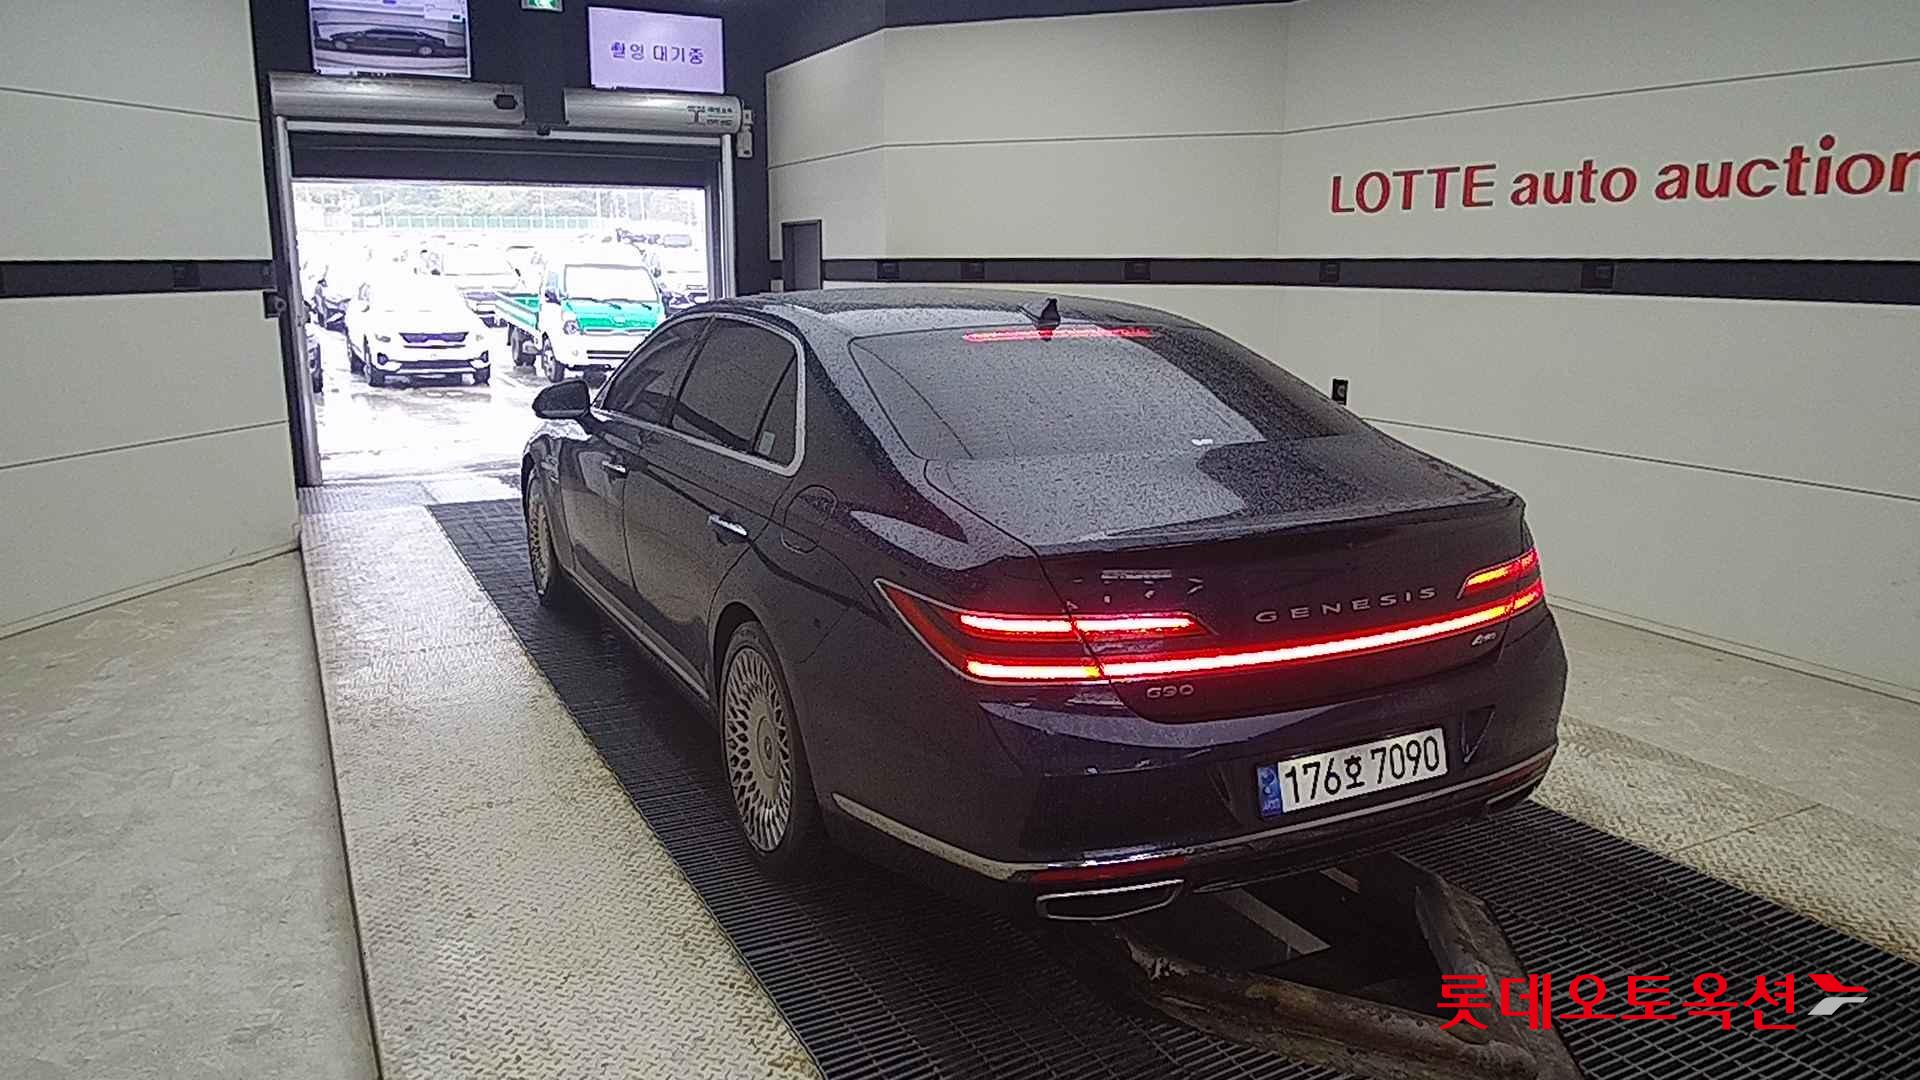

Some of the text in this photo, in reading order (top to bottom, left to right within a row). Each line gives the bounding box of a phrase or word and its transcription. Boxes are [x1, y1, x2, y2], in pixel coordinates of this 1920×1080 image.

[653, 45, 704, 64] 대기중
[1331, 163, 1496, 213] LOTTE
[1510, 160, 1638, 206] auto
[1255, 587, 1435, 623] GENESIS
[1146, 684, 1194, 698] G90
[1285, 736, 1440, 803] 176호 7090
